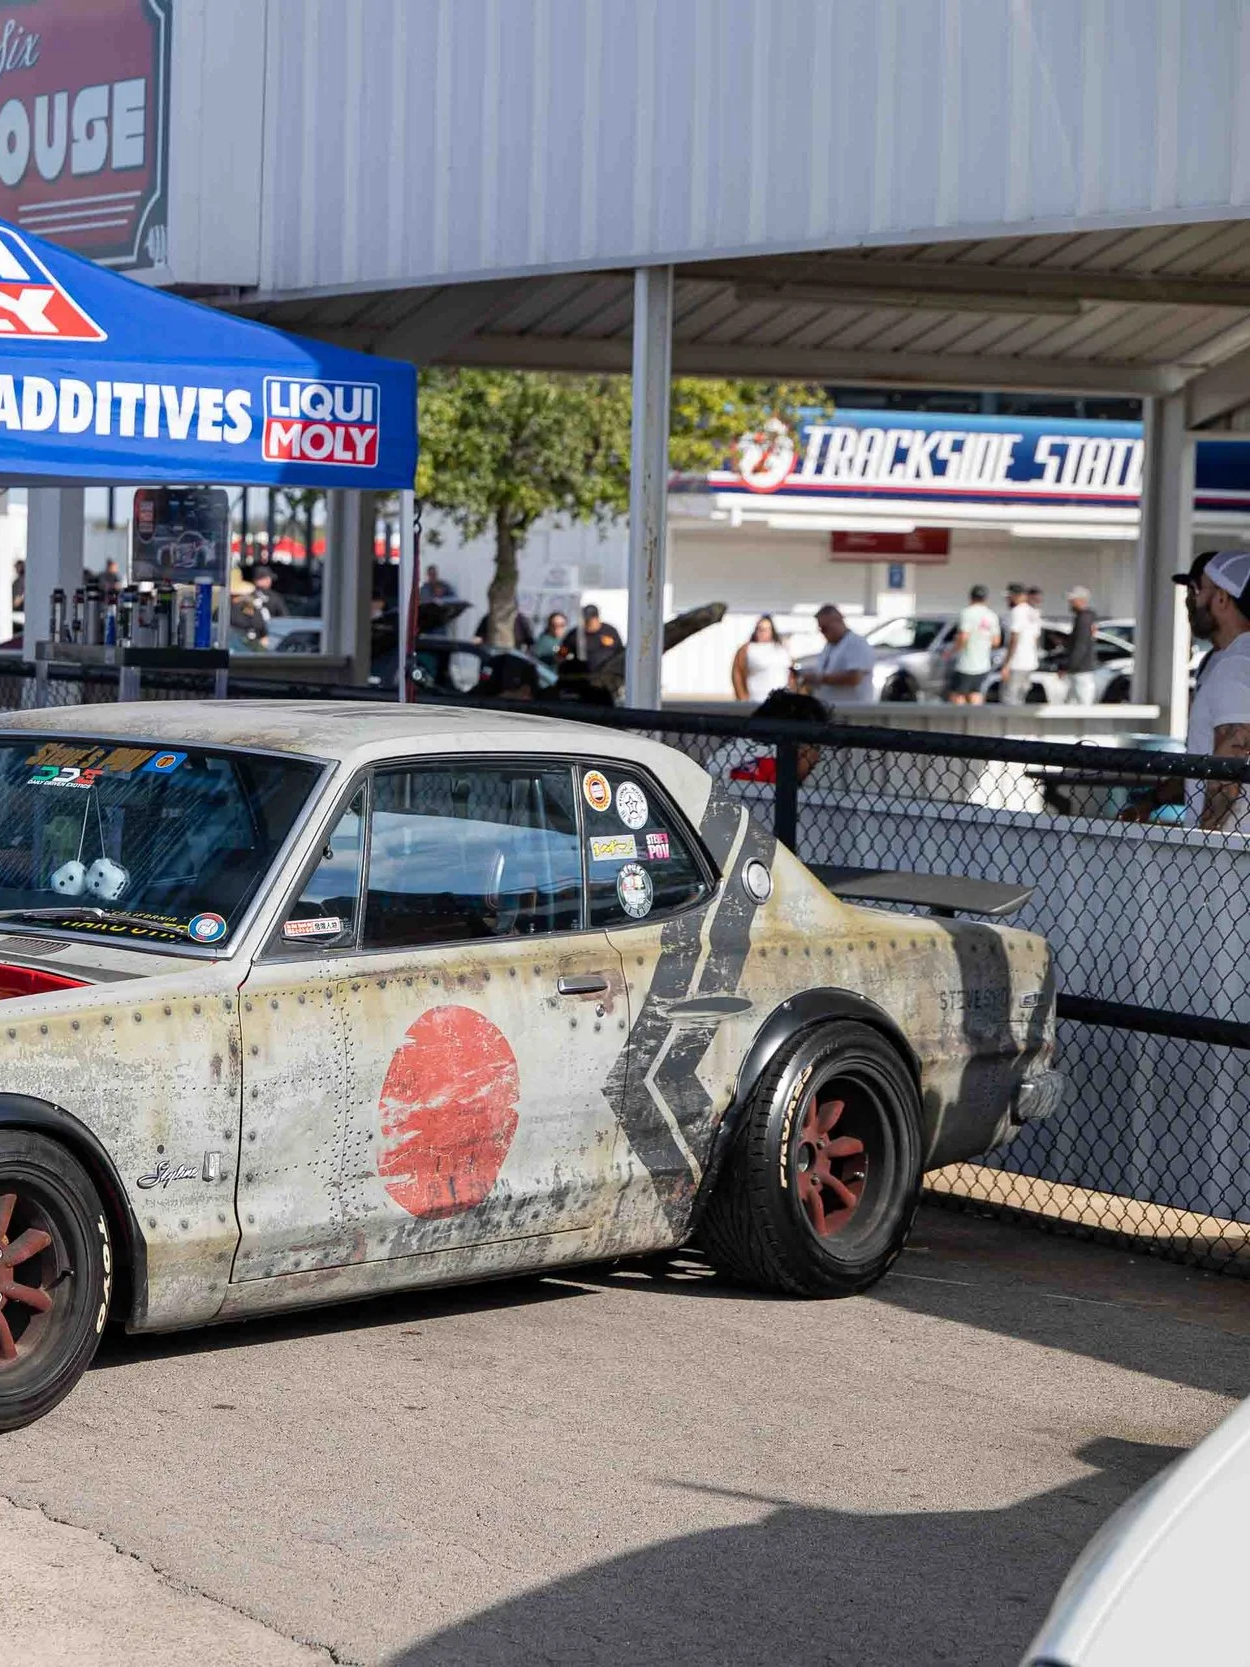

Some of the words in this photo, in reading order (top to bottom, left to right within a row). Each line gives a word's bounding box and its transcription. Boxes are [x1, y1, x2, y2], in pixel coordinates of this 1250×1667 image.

[270, 380, 374, 423] LIQUI
[268, 423, 378, 462] MOLY
[794, 425, 1023, 486] TRACKSIDE
[1034, 434, 1145, 492] STATI
[111, 910, 179, 923] CALIFORNIA
[136, 1160, 199, 1190] Skyline
[96, 1214, 111, 1335] TOYO
